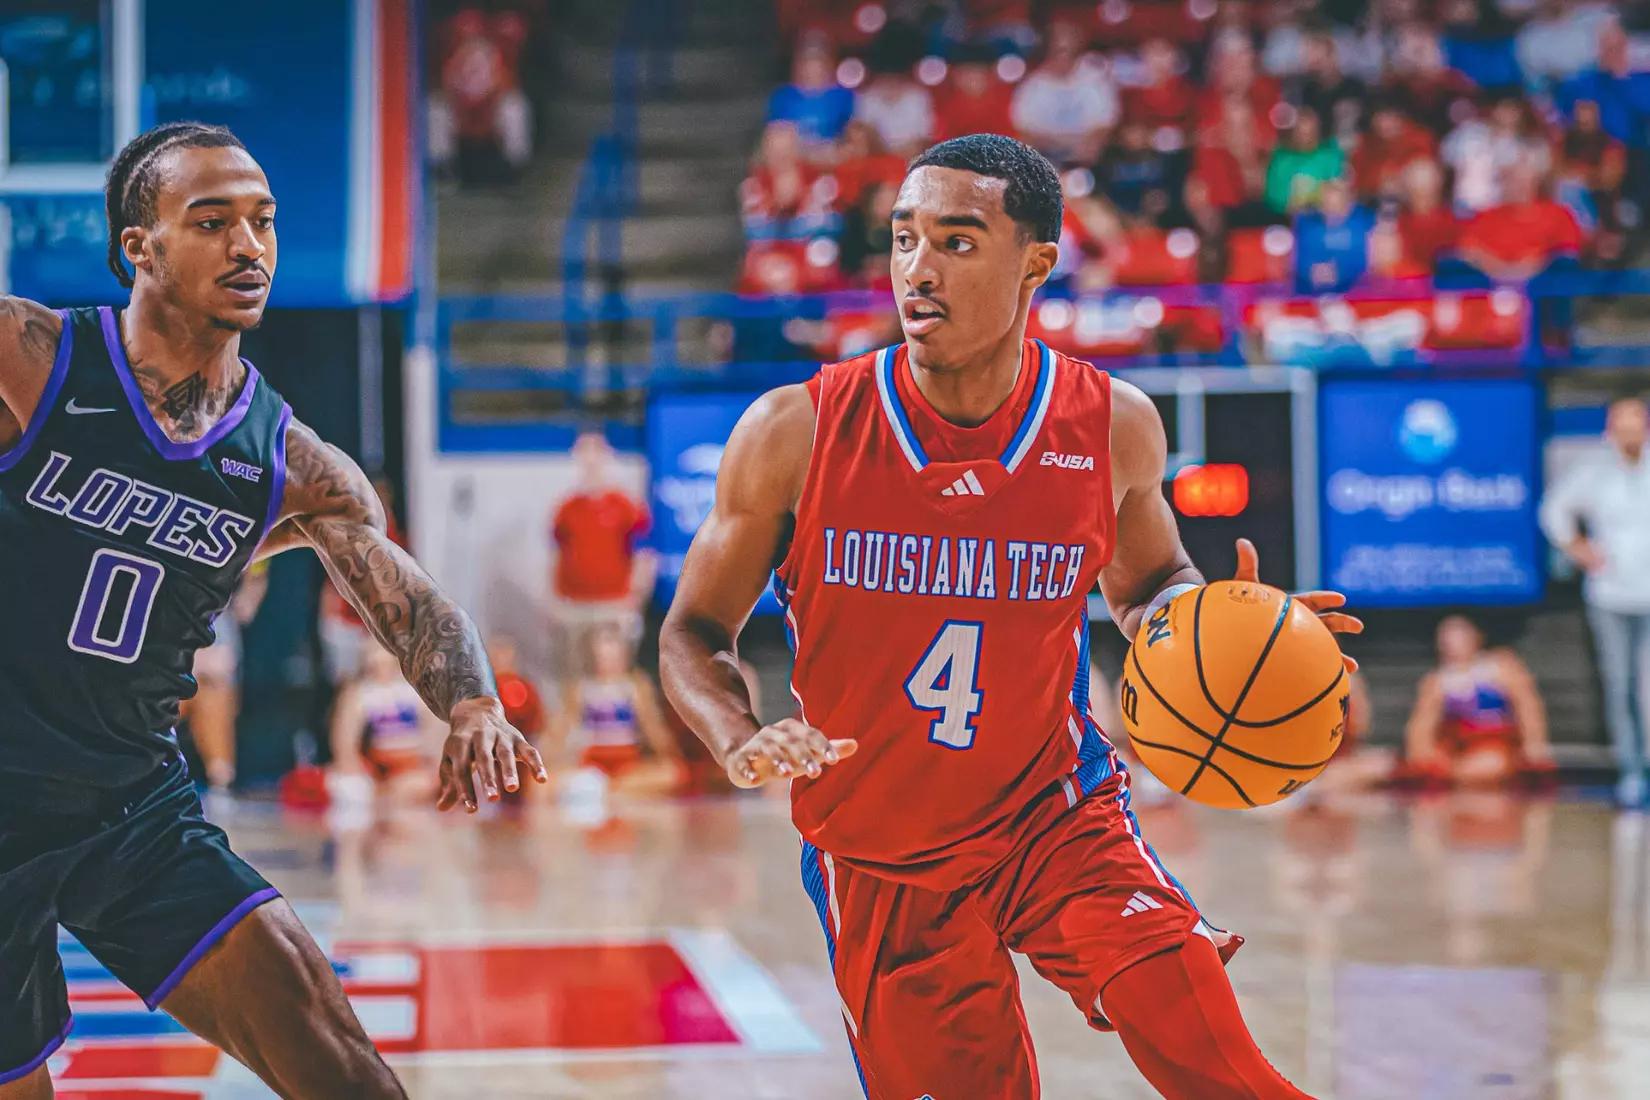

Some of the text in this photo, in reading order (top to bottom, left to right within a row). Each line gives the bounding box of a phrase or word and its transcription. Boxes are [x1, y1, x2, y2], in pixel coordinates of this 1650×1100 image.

[26, 450, 256, 568] LOPES
[221, 457, 263, 483] WAC
[67, 547, 165, 664] 0
[823, 528, 1085, 600] LOUISIANA TECH
[902, 618, 984, 749] 4
